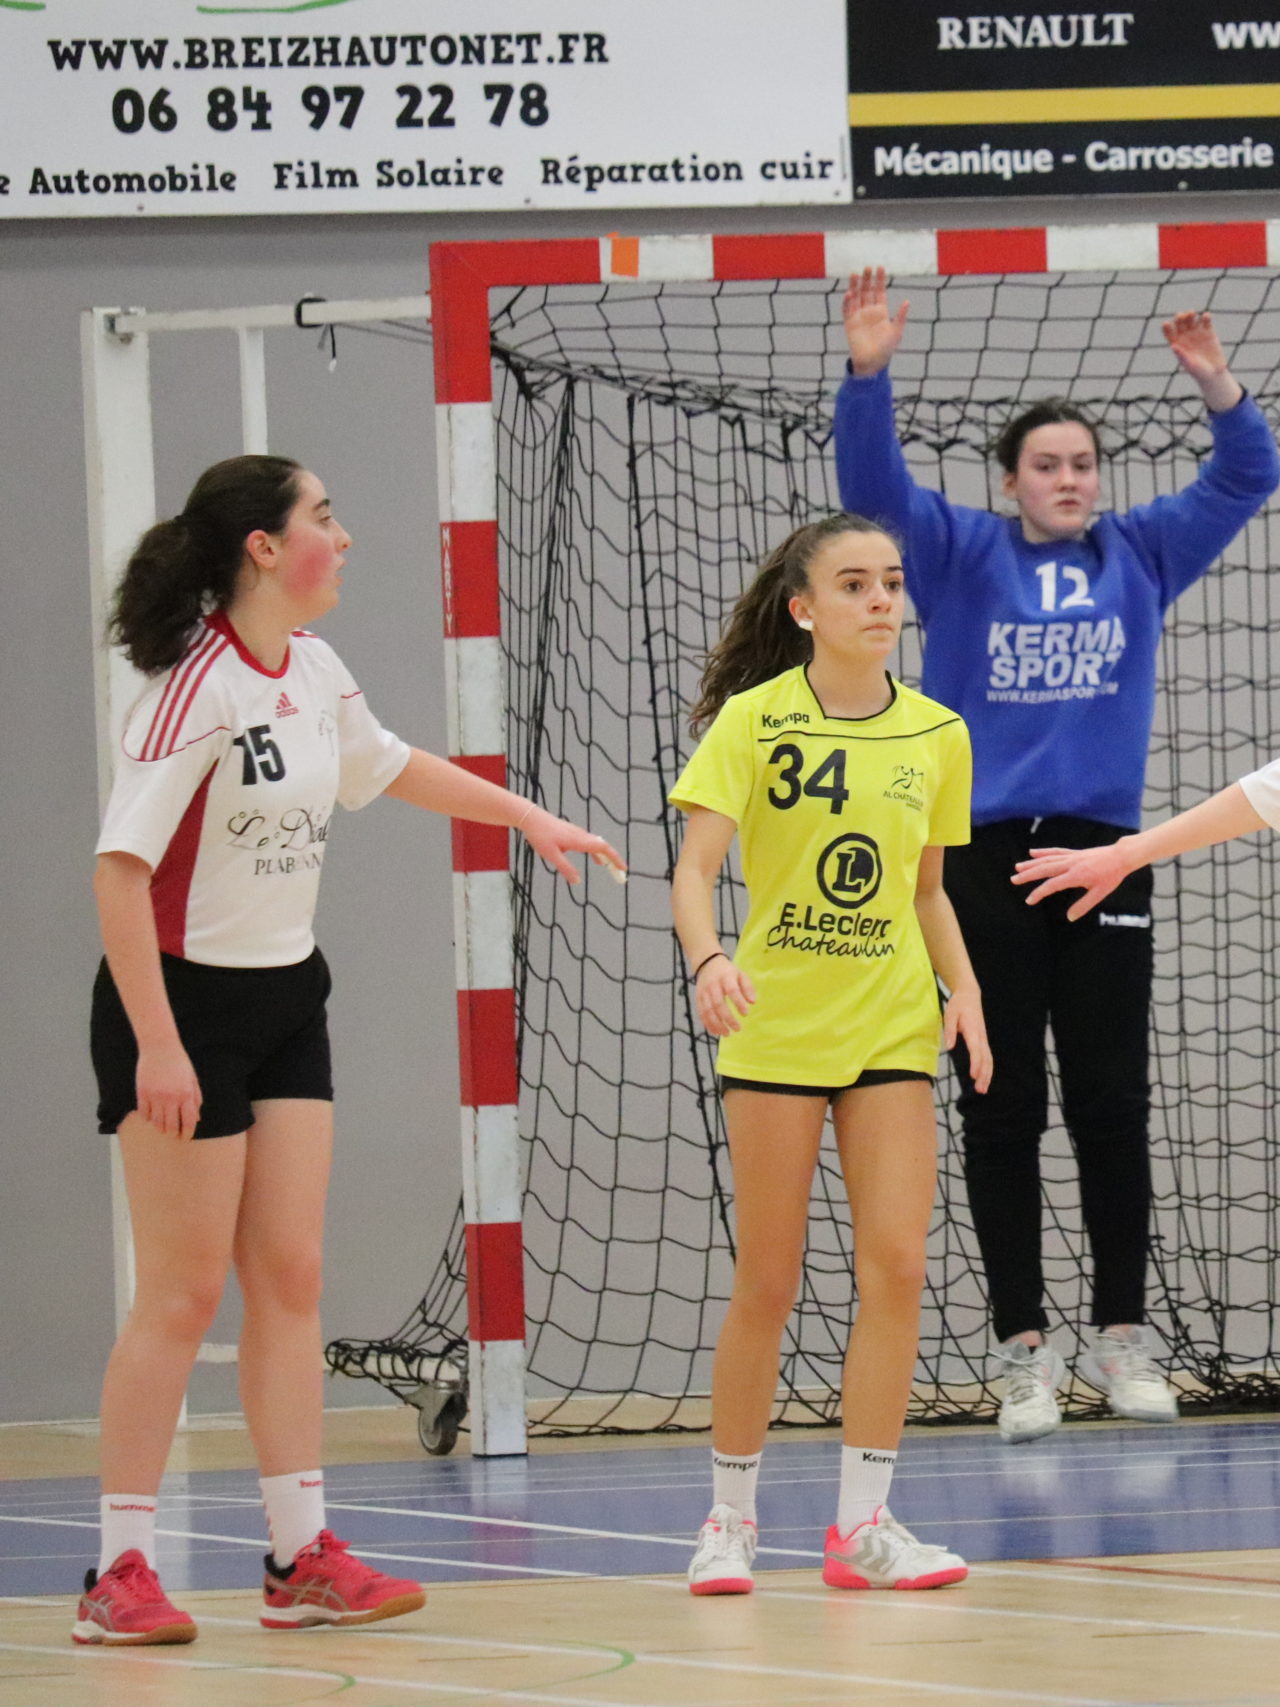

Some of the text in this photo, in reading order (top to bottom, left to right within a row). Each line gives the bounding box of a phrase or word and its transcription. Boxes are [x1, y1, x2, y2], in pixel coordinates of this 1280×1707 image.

[47, 33, 609, 70] WWW.BREIZHAUTONET.FR
[937, 13, 1134, 50] RENAULT
[111, 82, 550, 134] 06 84 97 22 78
[29, 164, 237, 195] Automobile
[273, 159, 359, 190] Film
[376, 158, 504, 188] Solaire
[541, 154, 744, 193] Réparation
[760, 151, 834, 181] cuir
[874, 143, 1054, 180] Mécanique
[1085, 137, 1274, 172] Carrosserie
[1035, 561, 1095, 612] 12
[987, 616, 1126, 657] KERMA
[762, 712, 810, 728] Kempa
[233, 724, 286, 785] 15
[768, 744, 849, 815] 34
[780, 902, 892, 938] E.Leclerc
[767, 925, 895, 958] Chateaulin
